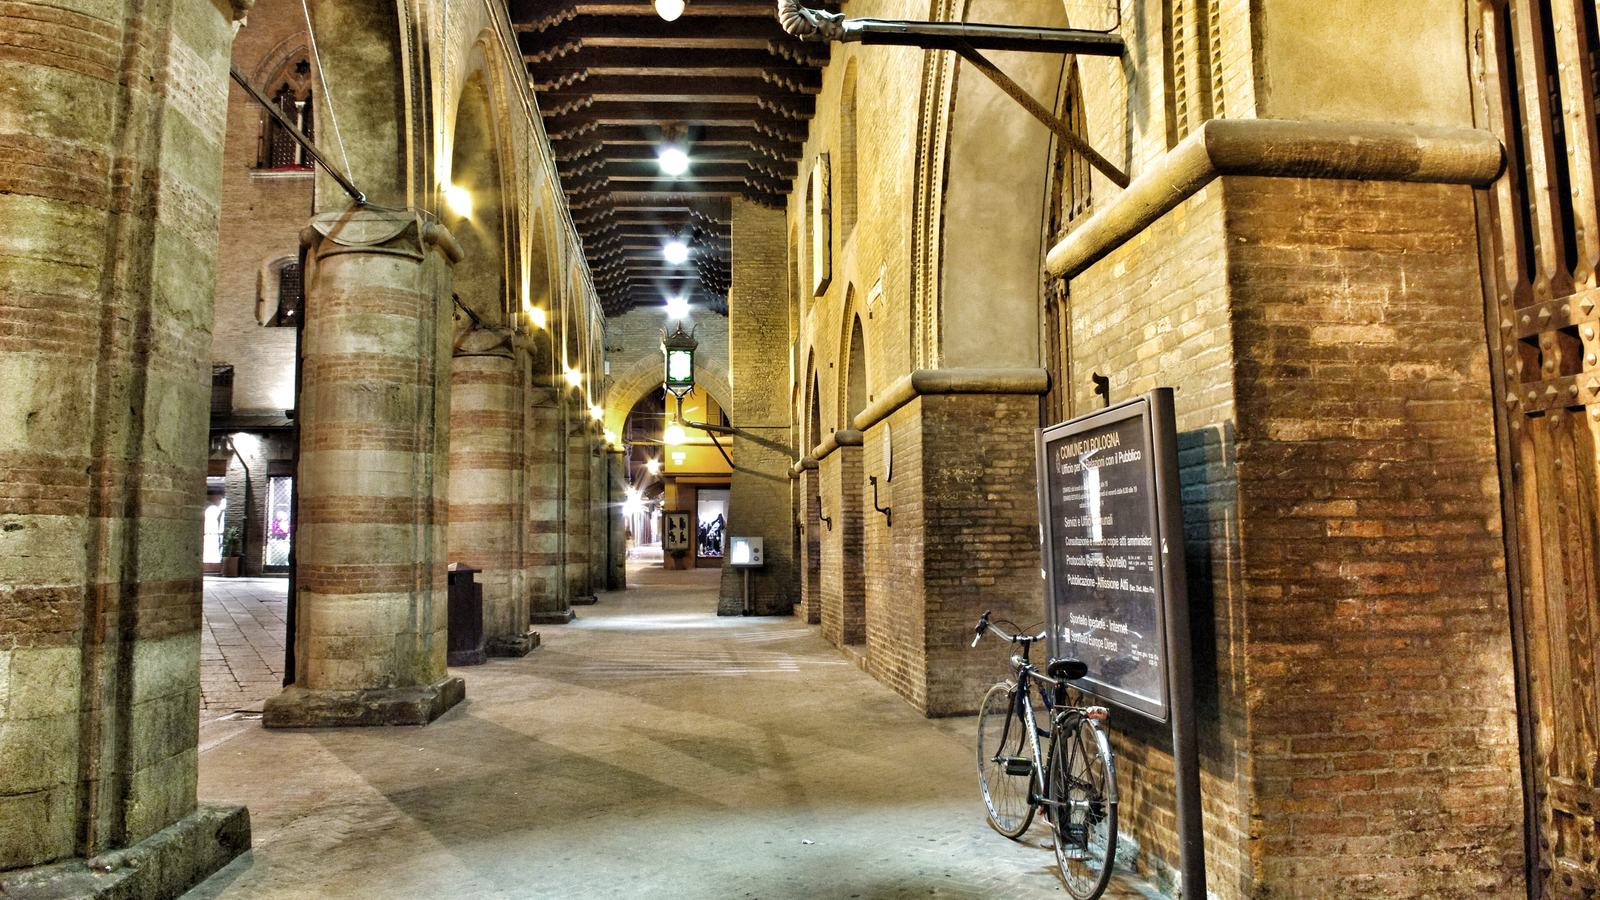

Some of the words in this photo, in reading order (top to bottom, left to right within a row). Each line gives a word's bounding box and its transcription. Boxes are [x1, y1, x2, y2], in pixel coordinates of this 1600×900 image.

[1060, 441, 1083, 459] COMUNE
[1084, 440, 1089, 454] DI
[1090, 432, 1121, 452] BOLOGNA
[1061, 463, 1074, 475] Ufficio
[1105, 456, 1114, 466] con
[1119, 448, 1141, 464] Pubblico
[1064, 516, 1077, 528] Servizi
[1065, 536, 1089, 546] Consultazione
[1107, 535, 1119, 548] copie
[1119, 535, 1127, 546] atti
[1066, 555, 1086, 566] Protocollo
[1086, 554, 1105, 567] Generale
[1105, 555, 1127, 571] Sportello
[1067, 574, 1095, 587] Pubblicazione
[1097, 575, 1119, 590] Affissione
[1120, 578, 1129, 591] Atti
[1069, 612, 1087, 626] Sportello
[1109, 619, 1128, 634] Internet
[1071, 630, 1088, 645] Sportello
[1088, 634, 1103, 650] Europe
[1104, 637, 1118, 652] Direct
